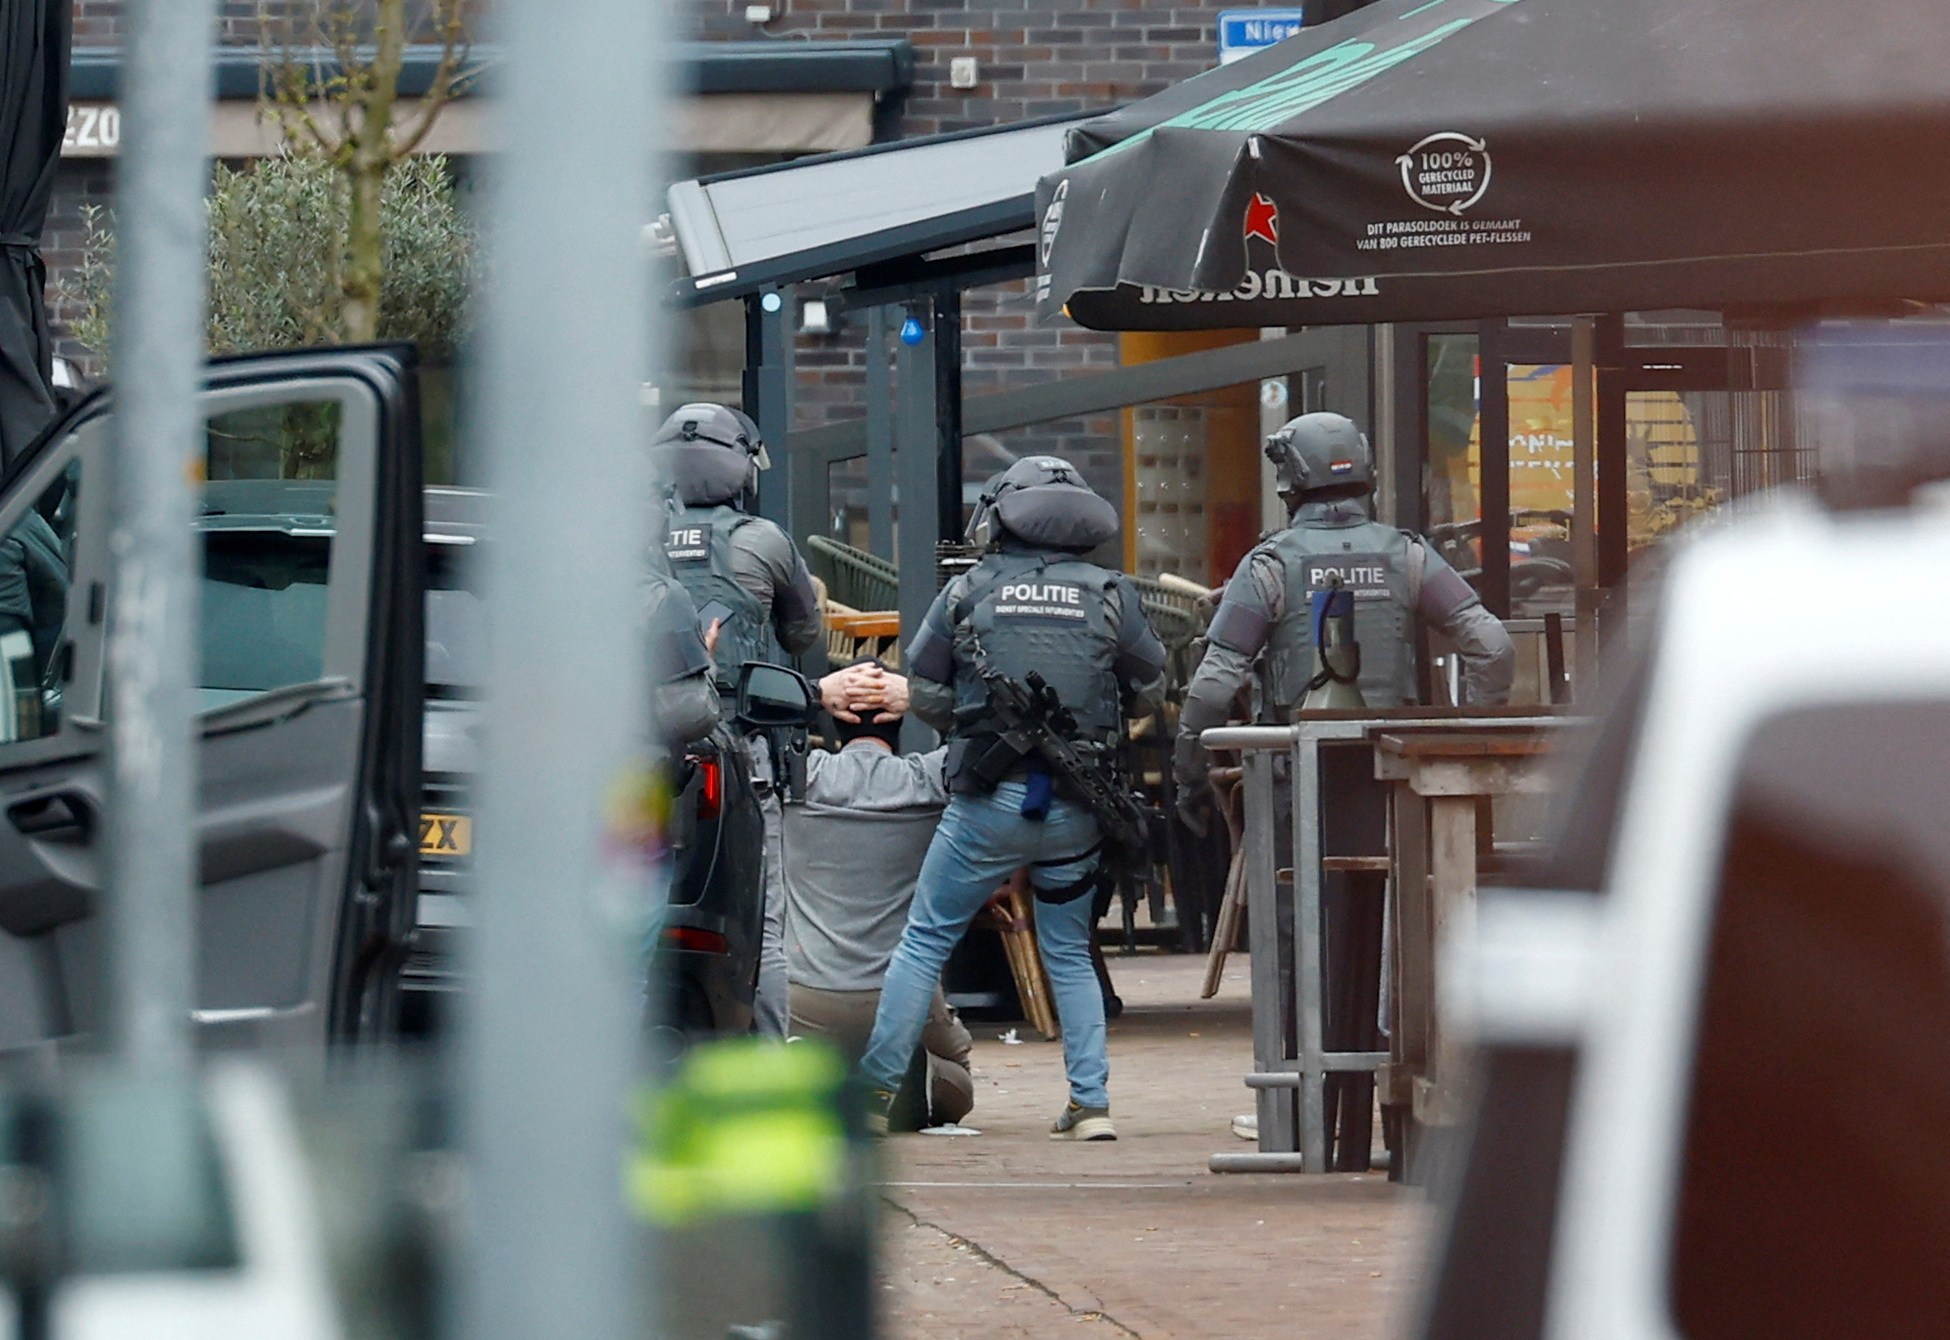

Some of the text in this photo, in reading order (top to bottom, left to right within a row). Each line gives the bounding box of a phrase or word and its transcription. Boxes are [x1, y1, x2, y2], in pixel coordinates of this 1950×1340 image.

[1421, 152, 1474, 171] 100%
[1418, 169, 1475, 184] GERECYCLED
[1421, 182, 1474, 196] MATERIAAL
[1367, 219, 1521, 236] DIT PARASOLDOEK IS GEMAAKT
[1356, 238, 1378, 251] VAN
[1400, 234, 1467, 248] GERECYCLEDE
[1469, 231, 1532, 245] PET-FLESSEN
[664, 529, 702, 546] TIE
[1001, 583, 1080, 604] POLITIE
